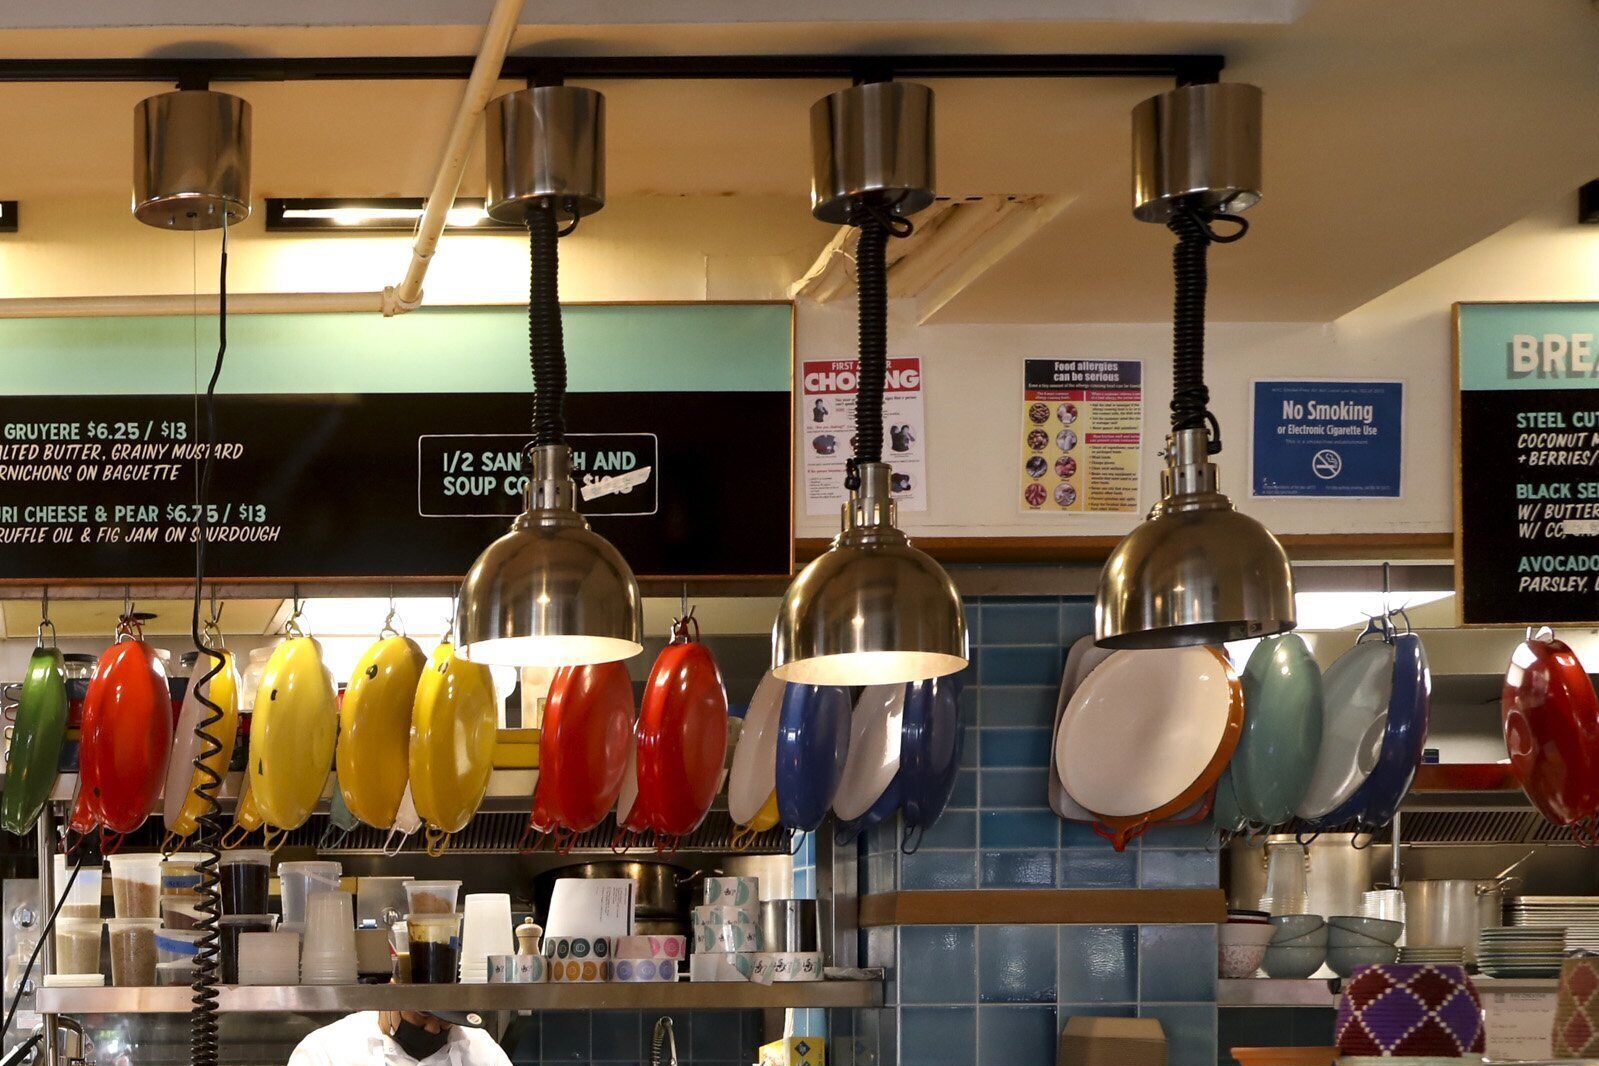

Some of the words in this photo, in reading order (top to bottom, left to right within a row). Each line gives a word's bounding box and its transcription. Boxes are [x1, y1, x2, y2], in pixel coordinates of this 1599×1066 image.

[1513, 333, 1599, 372] BRE
[832, 362, 854, 370] FIRST
[1055, 362, 1075, 371] Food
[1077, 362, 1118, 371] allergies
[805, 370, 919, 391] CHONG
[1054, 373, 1070, 381] can
[1072, 372, 1082, 380] be
[1085, 373, 1119, 381] serious
[1283, 401, 1303, 419] No
[1307, 401, 1373, 423] Smoking
[1516, 412, 1566, 428] STEEL
[4, 423, 80, 440] GRUYERE
[87, 422, 139, 440] $6.25
[161, 422, 187, 439] $13
[1277, 426, 1286, 434] or
[1288, 425, 1324, 434] Electronic
[1327, 425, 1361, 436] Cigarette
[1363, 426, 1377, 435] Use
[1518, 432, 1588, 448] COCONUT
[43, 444, 106, 461] BUTTER,
[112, 444, 169, 460] GRAINY
[443, 451, 474, 473] 1/2
[594, 451, 636, 470] AND
[77, 465, 98, 481] ON
[102, 465, 182, 481] BAGUETTE
[444, 476, 496, 496] SOUP
[1516, 483, 1571, 499] BLACK
[25, 506, 88, 523] CHEESE
[115, 505, 158, 522] PEAR
[166, 504, 218, 522] $6.75
[239, 504, 266, 522] $13
[53, 527, 73, 543] OIL
[97, 527, 120, 542] FIG
[125, 527, 158, 542] JAM
[165, 526, 188, 542] ON
[1519, 576, 1588, 593] PARSLEY,
